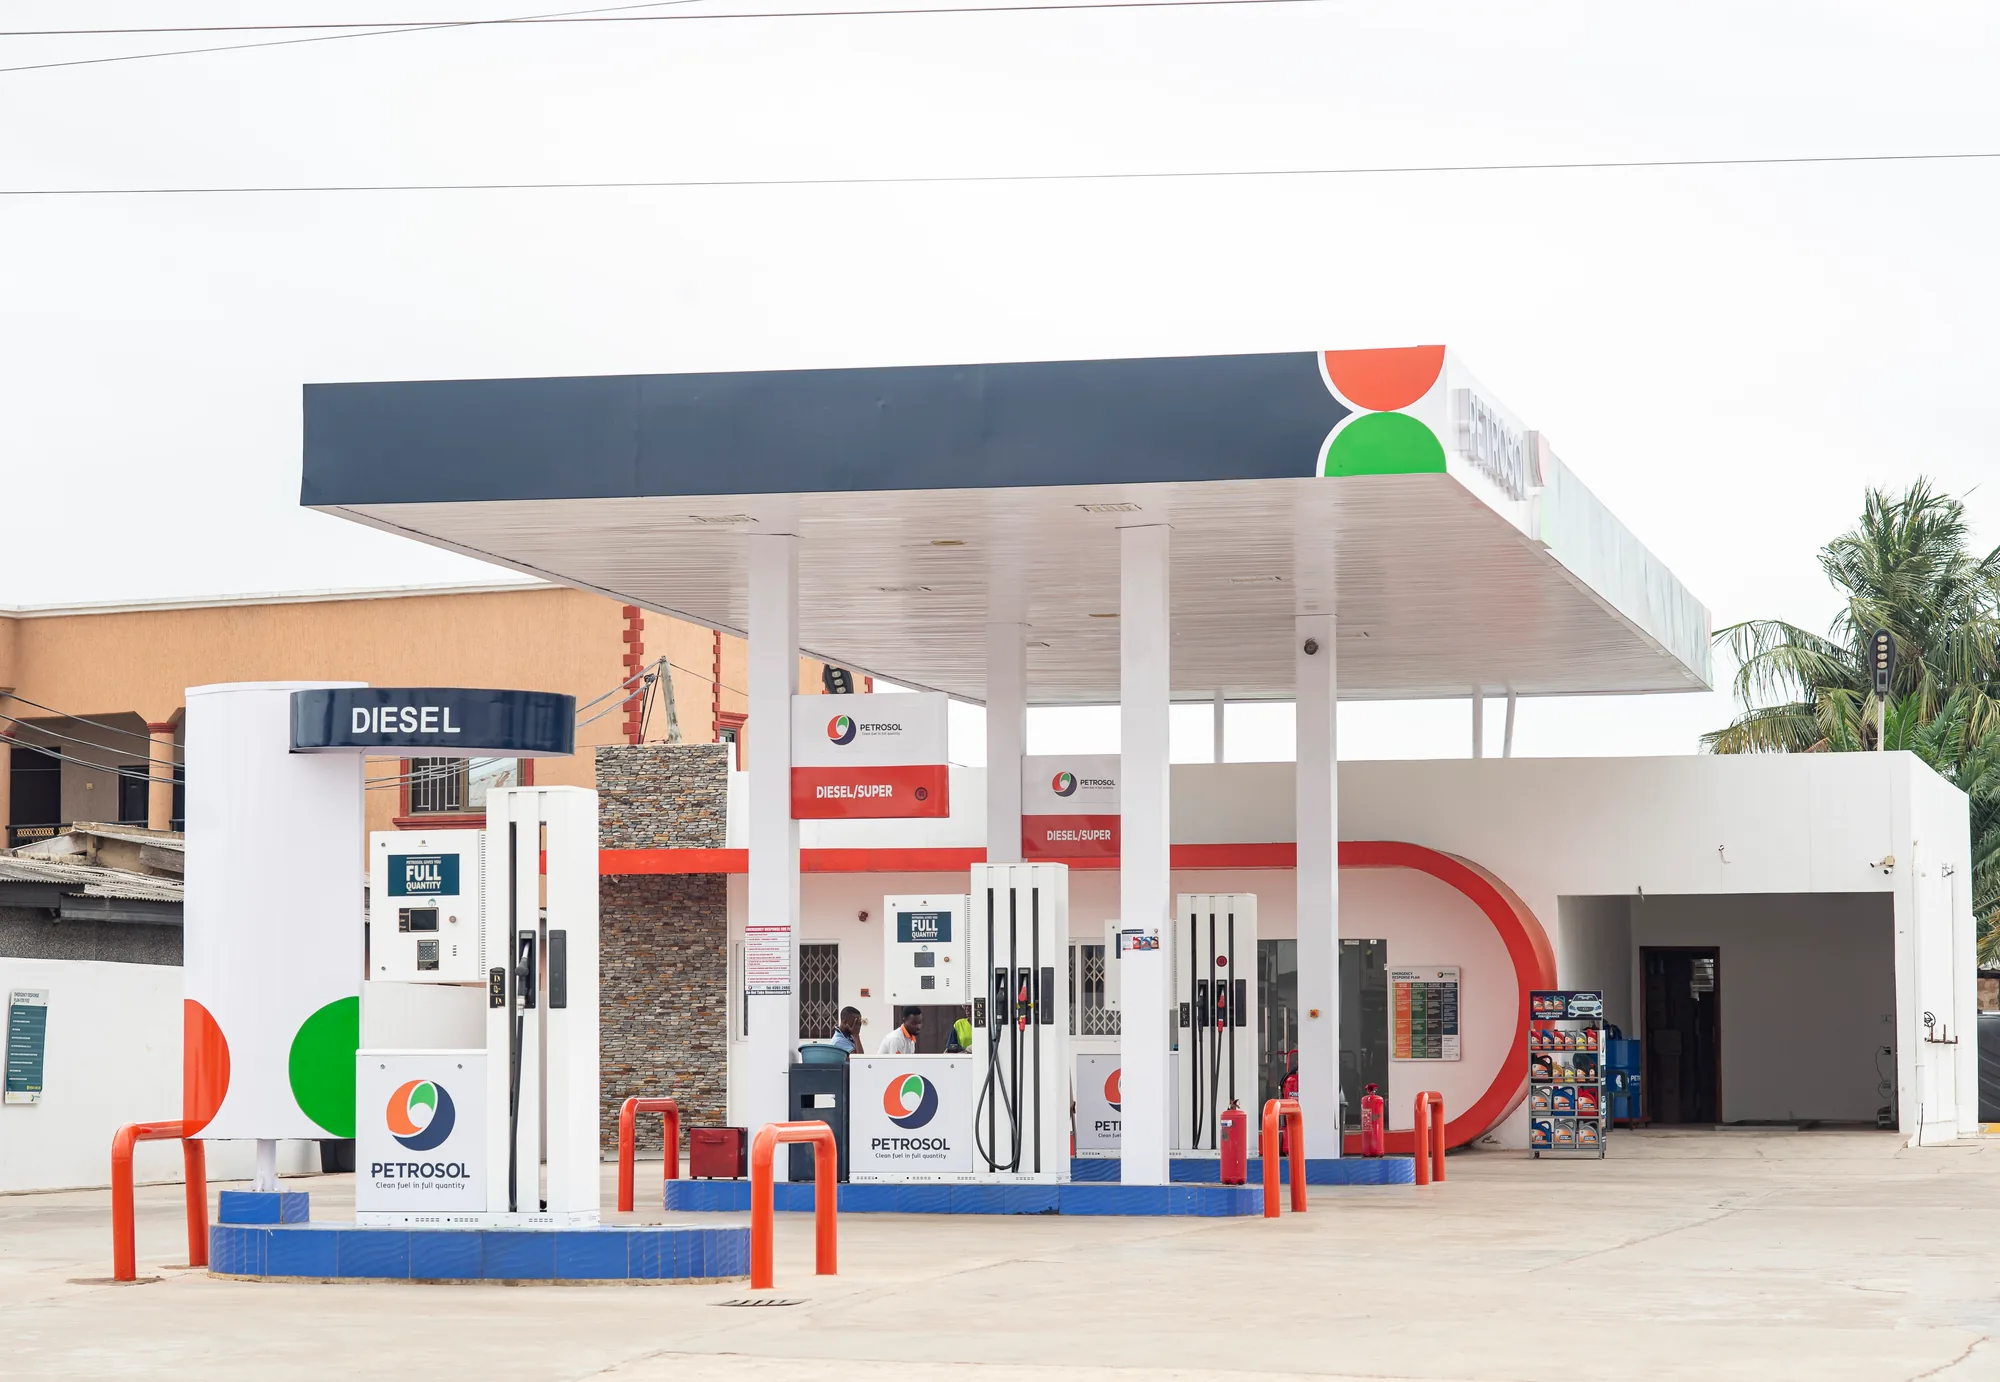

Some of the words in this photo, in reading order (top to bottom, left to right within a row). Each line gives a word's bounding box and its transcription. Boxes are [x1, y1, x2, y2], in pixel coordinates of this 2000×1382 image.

[352, 706, 461, 733] DIESEL
[860, 723, 902, 731] PETROSOL
[816, 785, 893, 799] DIESEL/SUPER
[1047, 830, 1111, 841] DIESEL/SUPER
[406, 865, 441, 881] FULL
[406, 881, 441, 891] QUANTITY
[912, 920, 938, 931] FULL
[1094, 1121, 1121, 1131] PET
[871, 1138, 950, 1150] PETROSOL
[371, 1162, 470, 1178] PETROSOL
[435, 1182, 465, 1190] quantity
